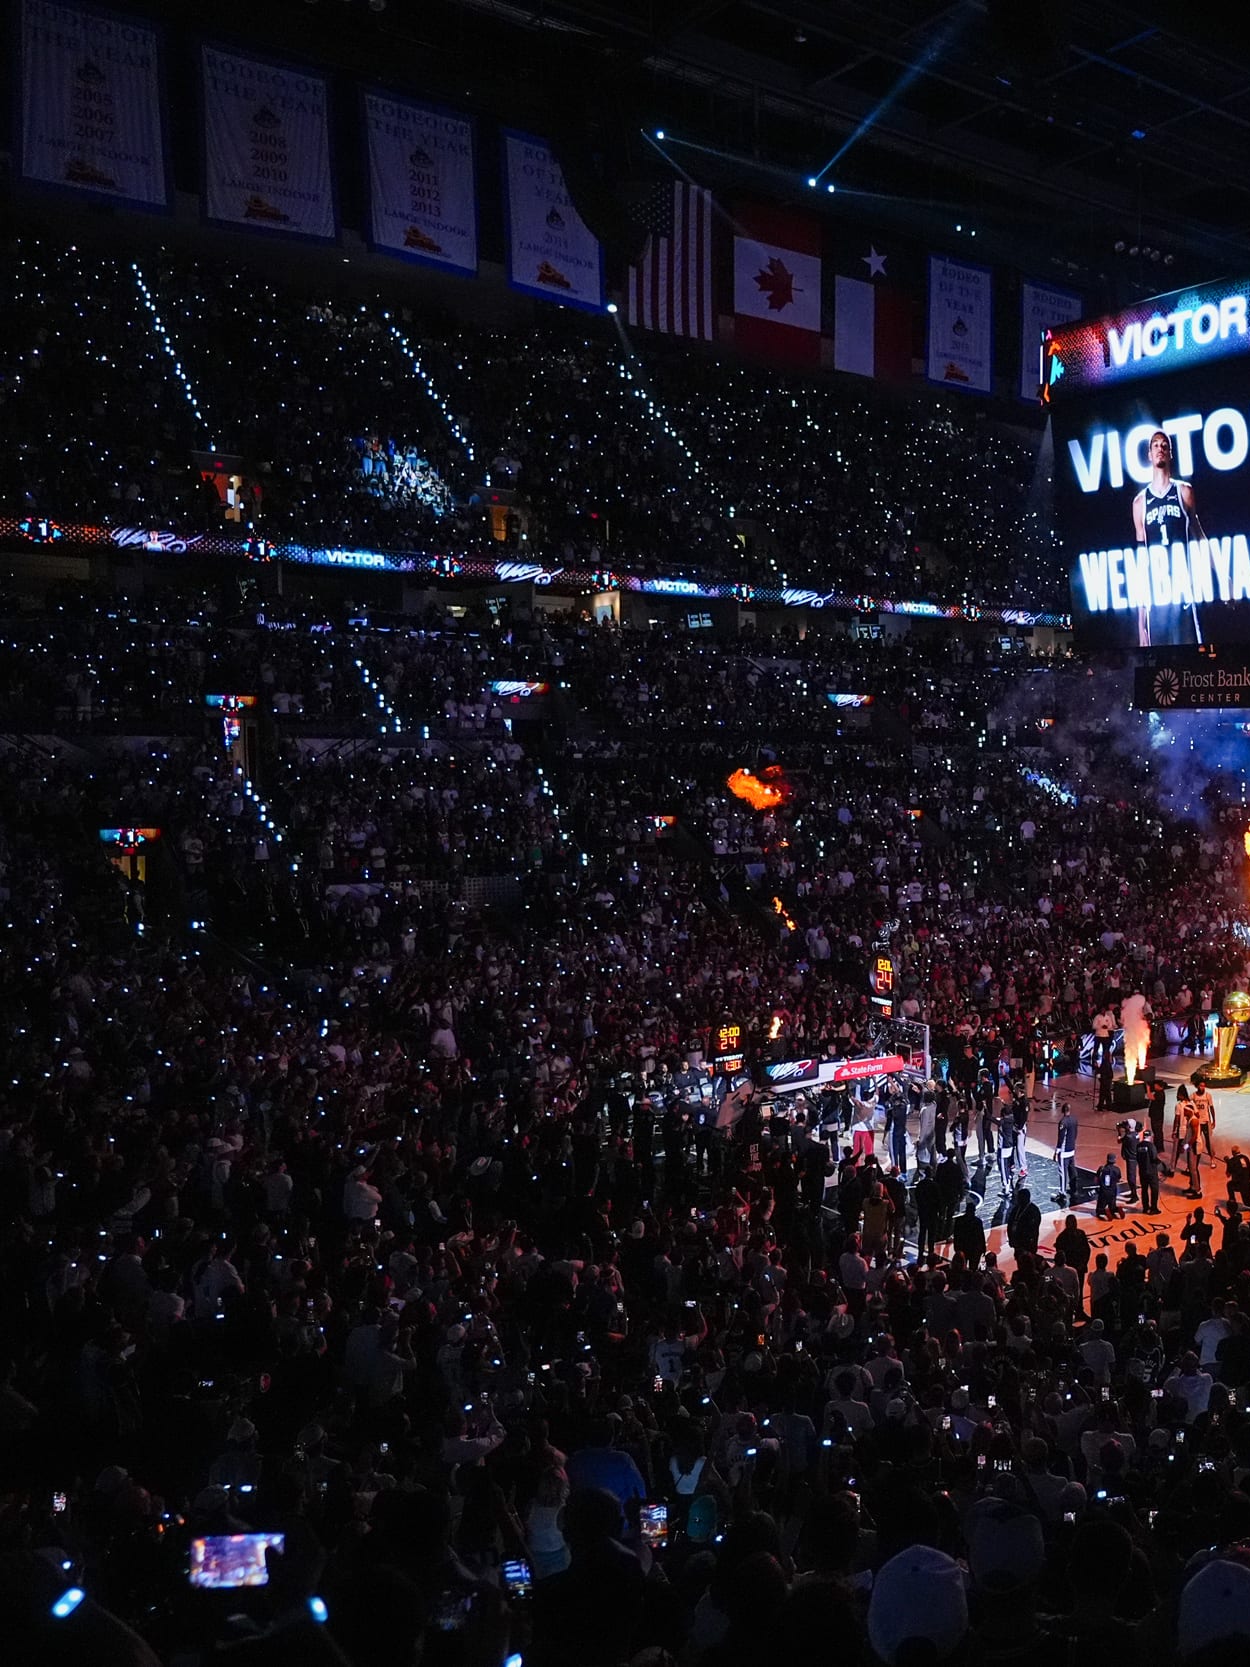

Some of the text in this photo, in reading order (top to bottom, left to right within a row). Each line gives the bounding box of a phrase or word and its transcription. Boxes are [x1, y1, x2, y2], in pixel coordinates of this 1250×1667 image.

[74, 123, 115, 144] 2007
[249, 131, 288, 150] 2008
[250, 148, 288, 166] 2009
[252, 164, 288, 183] 2010
[409, 168, 440, 186] 2011
[410, 183, 441, 202] 2012
[411, 200, 442, 218] 2013
[384, 207, 468, 237] LARGE INDOOR
[1108, 296, 1248, 367] VICTOR
[1160, 524, 1170, 546] 1
[326, 549, 385, 567] VICTOR
[653, 579, 698, 594] VICTOR
[902, 601, 938, 615] VICTOR
[1182, 668, 1215, 688] Frost
[1190, 692, 1242, 703] CENTER
[876, 970, 892, 990] 24
[719, 1027, 740, 1038] 12:00
[720, 1037, 737, 1050] 24
[725, 1061, 741, 1072] 1:30
[1088, 1220, 1172, 1249] inals
